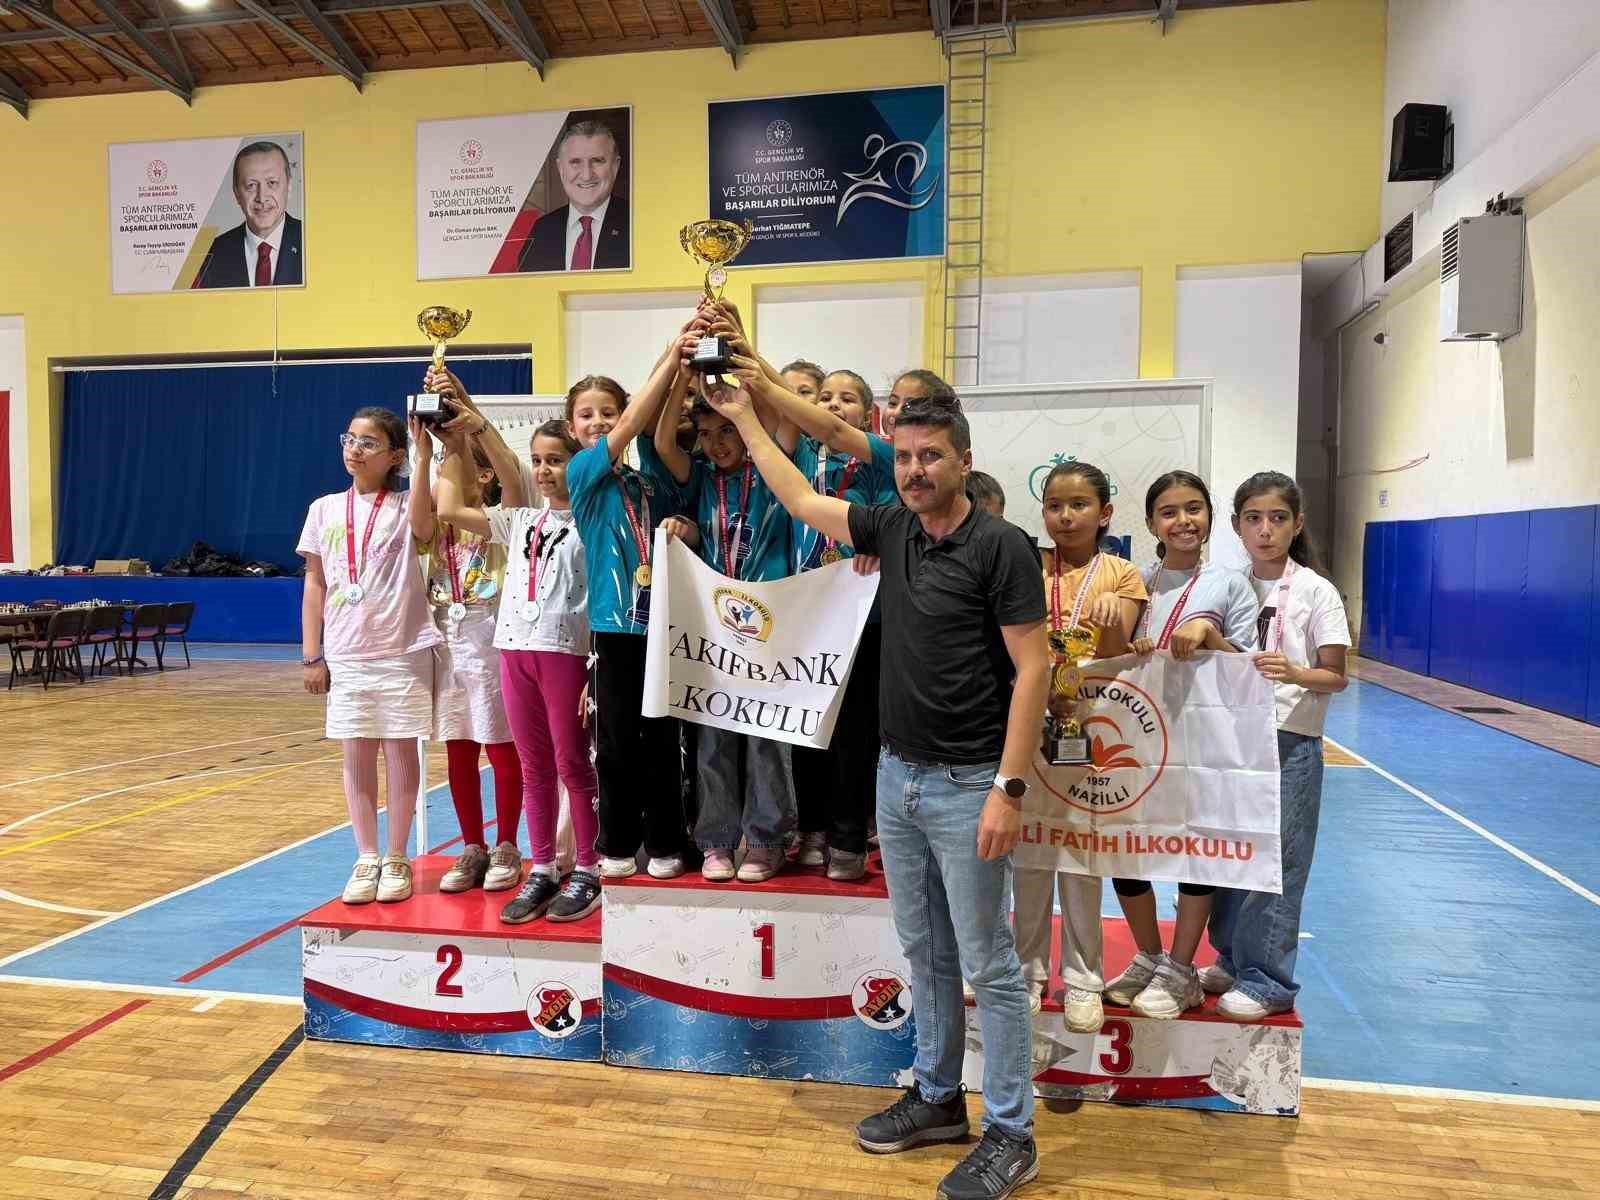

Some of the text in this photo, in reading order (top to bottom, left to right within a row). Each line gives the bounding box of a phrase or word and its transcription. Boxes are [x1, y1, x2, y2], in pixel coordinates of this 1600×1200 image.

[735, 168, 825, 185] TÜM ANTRENÖR
[452, 186, 501, 198] ANTRENÖR
[502, 186, 513, 195] VE
[722, 179, 838, 197] VE SPORCULARIMIZA
[186, 203, 196, 212] VE
[433, 195, 511, 208] SPORCULARIMIZA
[725, 195, 836, 212] BAŞARILAR DİLİYORUM
[123, 212, 193, 223] SPORCULARIMIZA
[429, 206, 516, 219] BAŞARILAR DİLİYORUM
[120, 222, 198, 233] BAŞARILAR DİLİYORUM
[668, 625, 842, 687] AKIFBANK
[1086, 776, 1111, 786] 1957
[1068, 785, 1129, 805] NAZİLLİ
[1050, 828, 1119, 853] FATİH
[1126, 830, 1253, 861] İLKOKULU
[753, 922, 776, 980] 1
[434, 943, 464, 998] 2
[865, 981, 902, 1016] AYDIN
[539, 990, 574, 1025] AYDIN
[1098, 1019, 1134, 1075] 3
